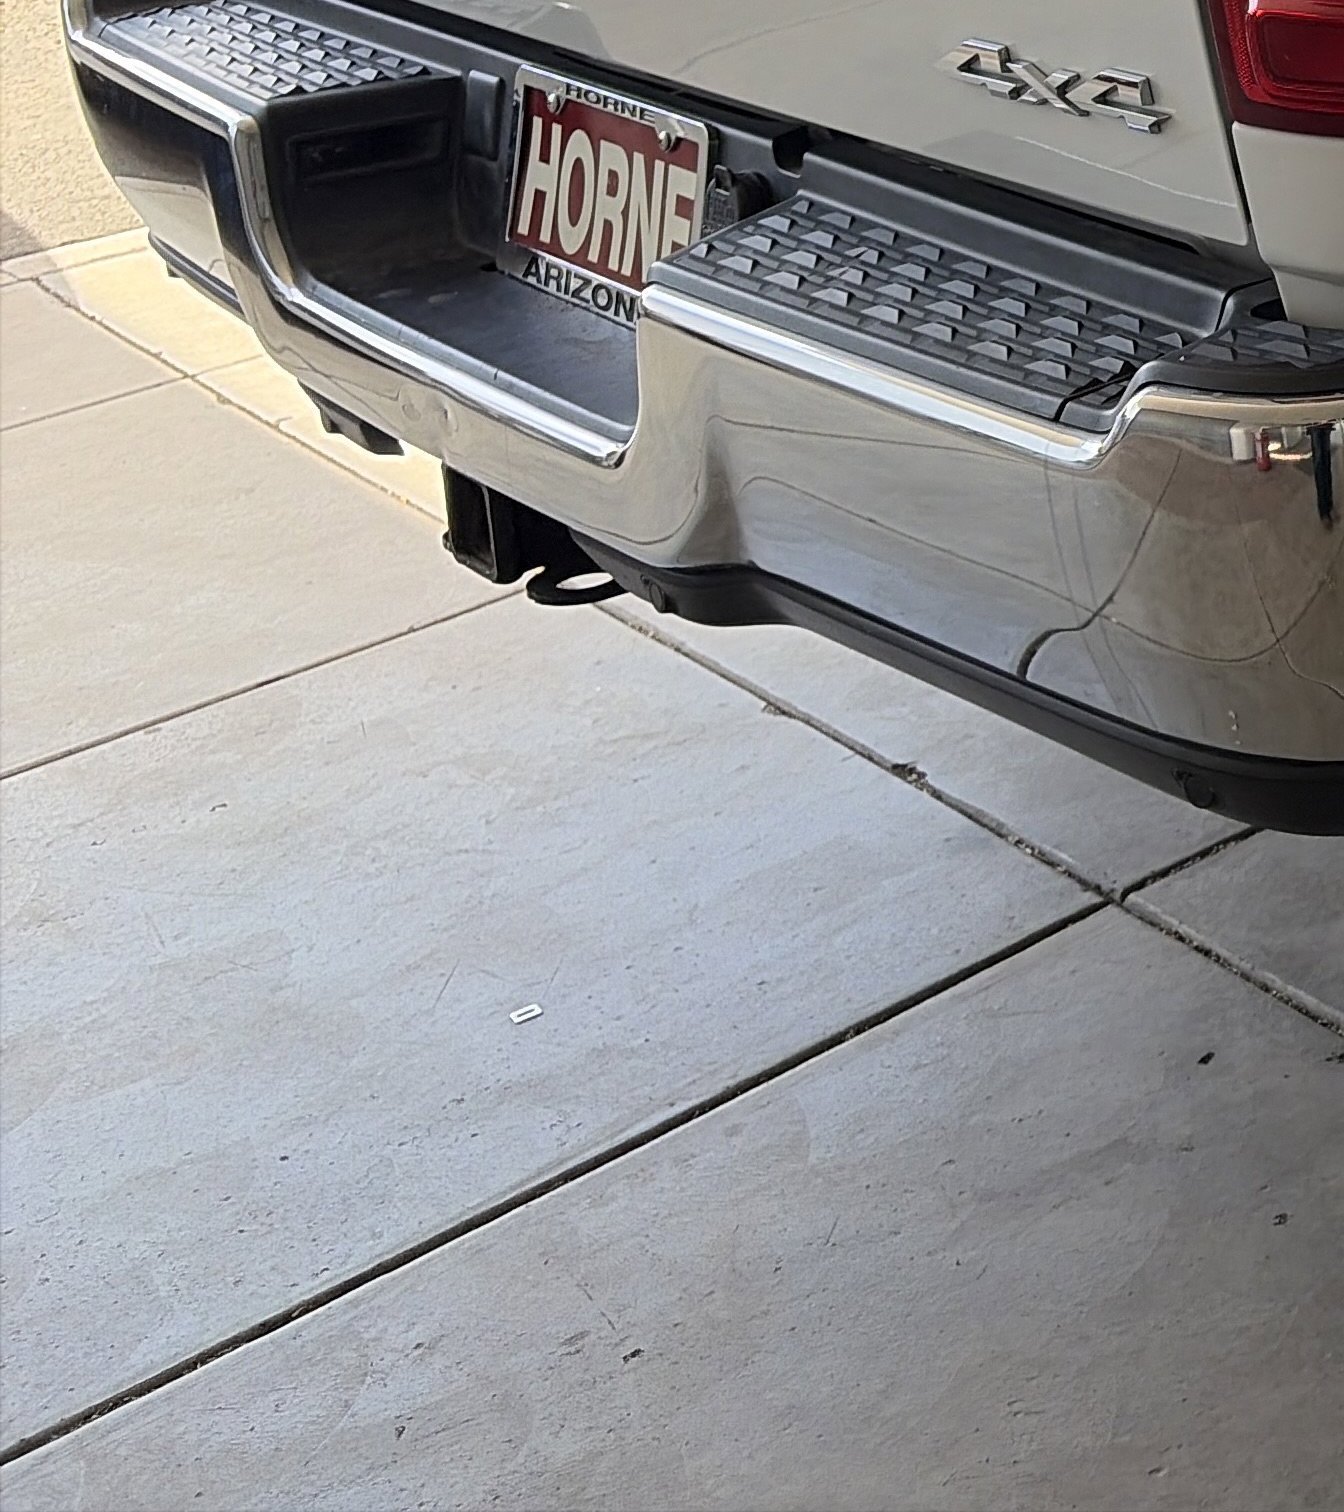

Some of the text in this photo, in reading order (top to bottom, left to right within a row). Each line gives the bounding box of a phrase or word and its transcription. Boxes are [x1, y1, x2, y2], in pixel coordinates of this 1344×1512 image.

[565, 84, 656, 122] HORNE
[517, 115, 697, 284] HORNE
[522, 255, 641, 323] ARIZON
